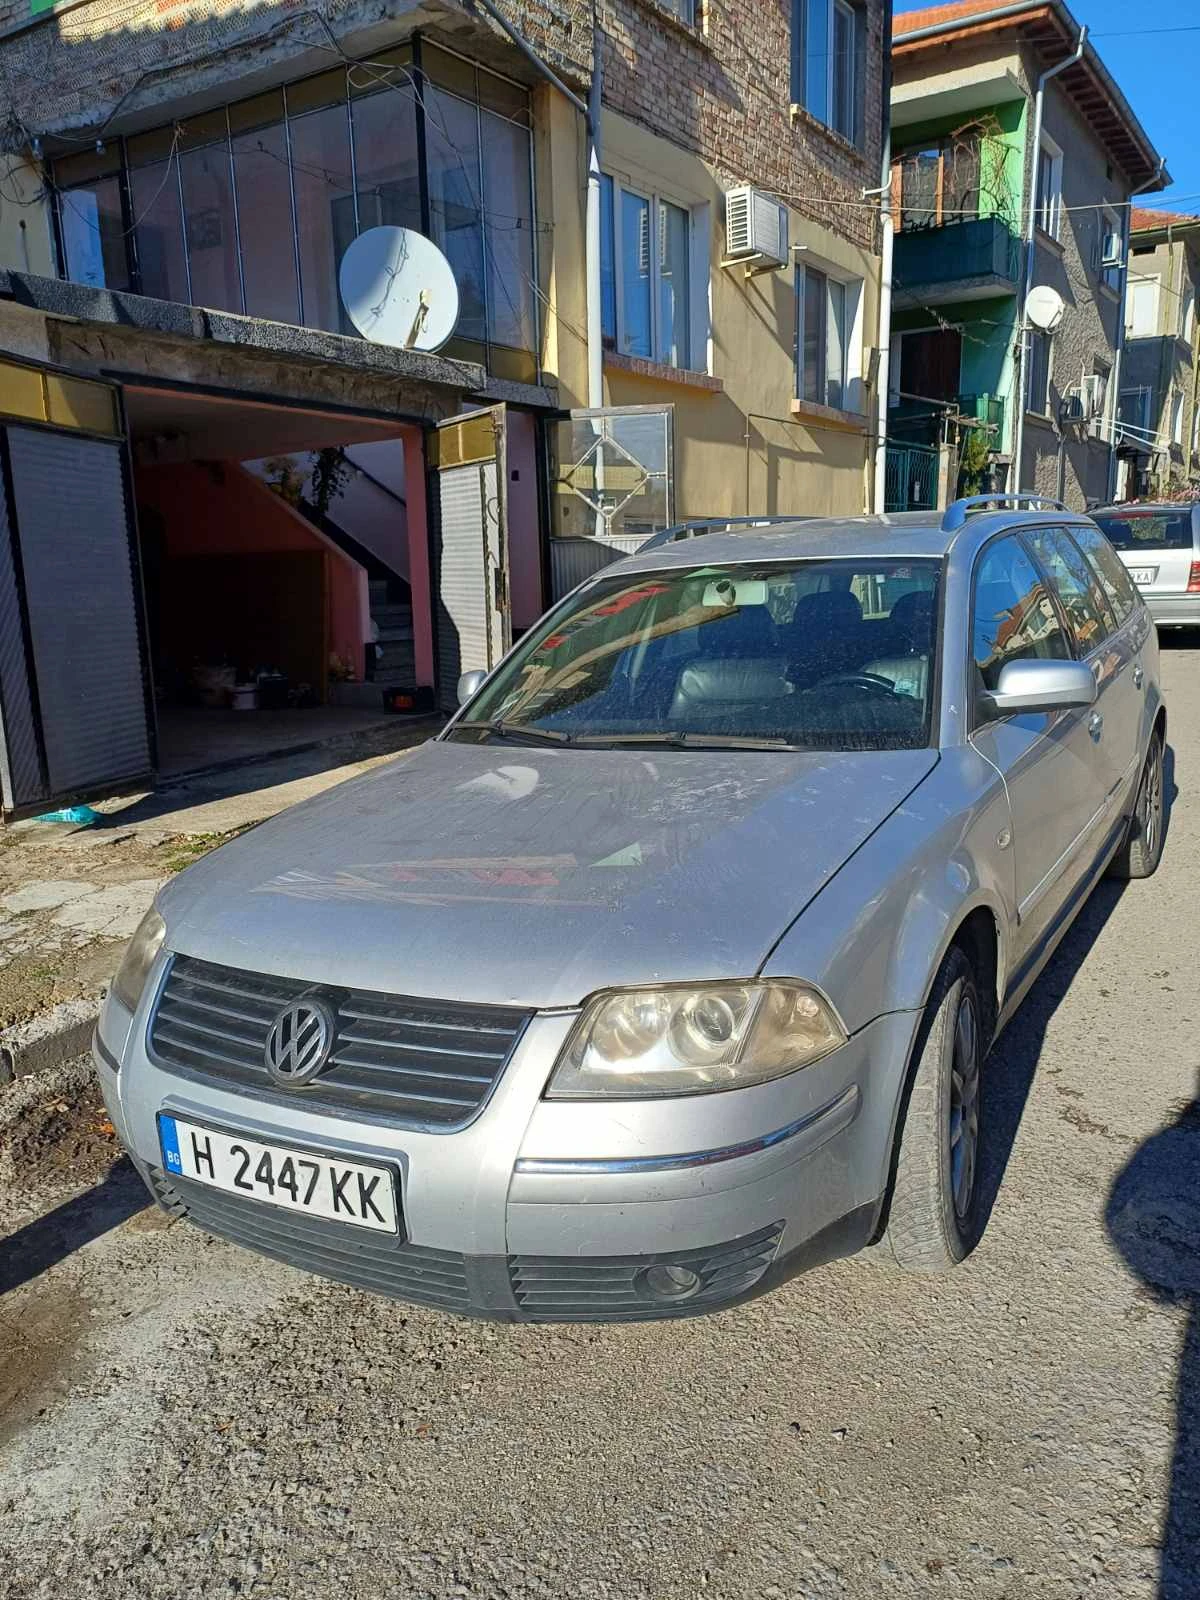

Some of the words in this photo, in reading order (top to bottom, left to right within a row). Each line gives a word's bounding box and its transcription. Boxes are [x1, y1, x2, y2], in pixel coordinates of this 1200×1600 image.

[167, 1150, 180, 1165] BG
[190, 1132, 215, 1179] H
[230, 1144, 320, 1205] 2447
[329, 1166, 386, 1223] KK
